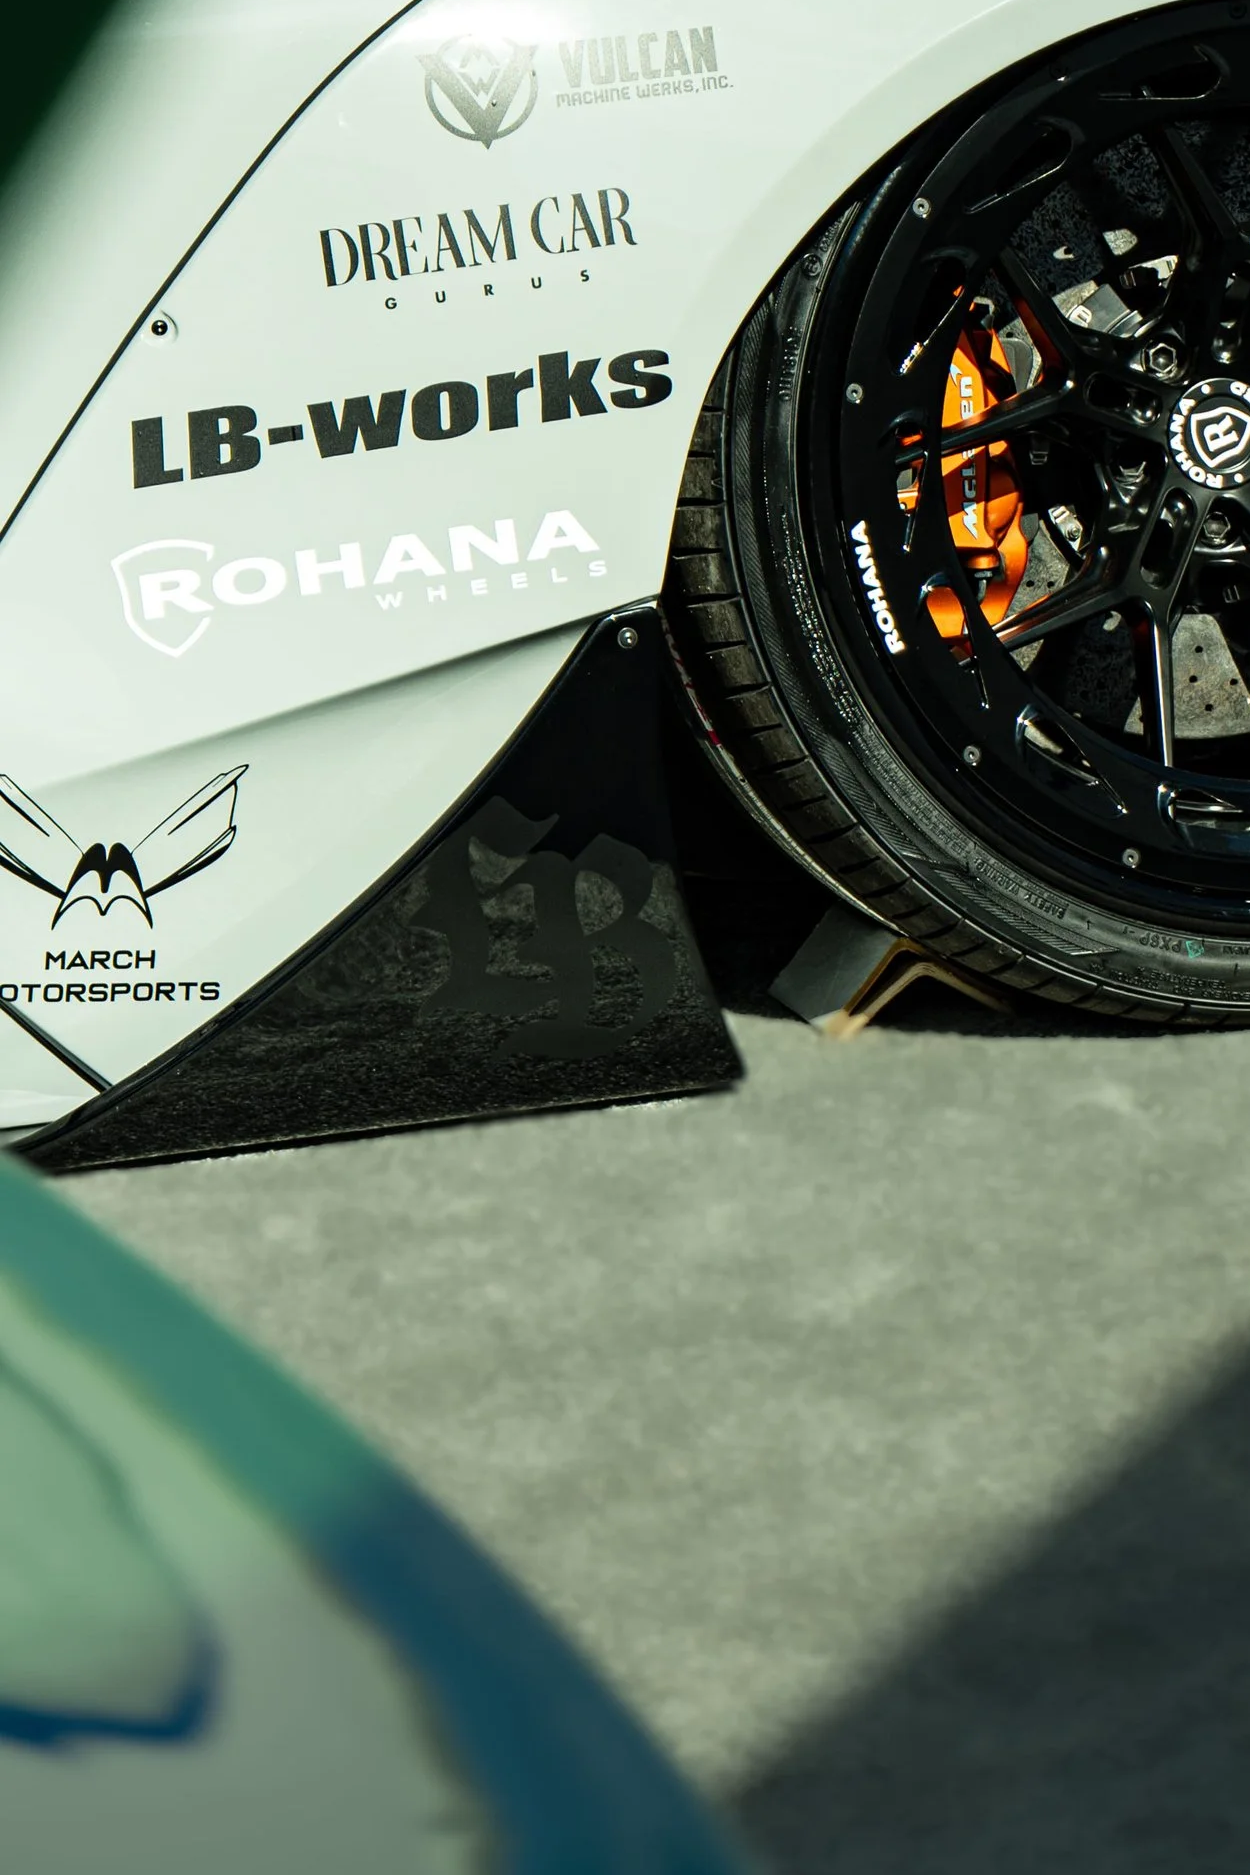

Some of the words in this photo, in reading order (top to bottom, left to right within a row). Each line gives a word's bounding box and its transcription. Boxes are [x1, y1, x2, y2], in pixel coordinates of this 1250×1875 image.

[558, 26, 719, 88] VULCAN
[555, 86, 631, 108] MACHINE
[318, 203, 518, 287] DREAM
[530, 187, 638, 254] CAR
[384, 269, 590, 310] GURUS
[131, 348, 674, 489] LB-works
[138, 509, 600, 621] ROHANA
[375, 559, 609, 611] WHEELS
[849, 519, 905, 657] ROHANA
[45, 950, 156, 970] MARCH
